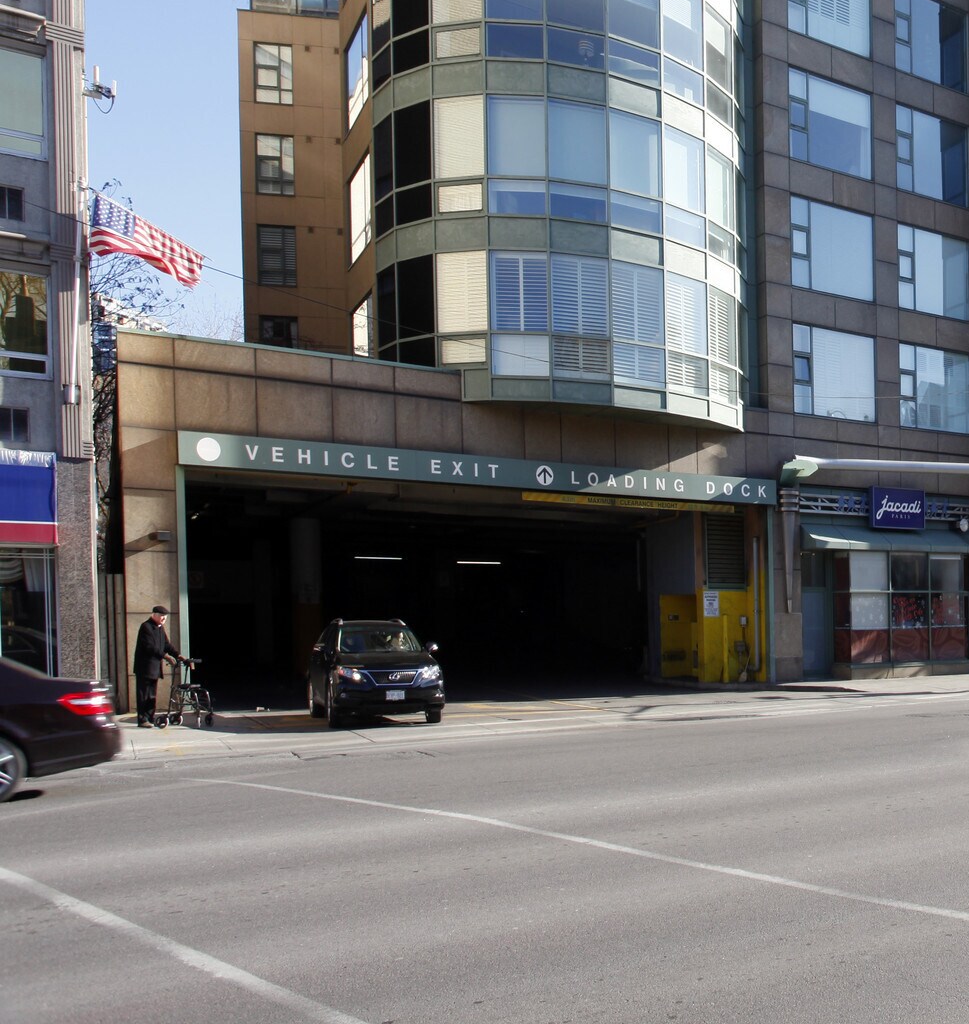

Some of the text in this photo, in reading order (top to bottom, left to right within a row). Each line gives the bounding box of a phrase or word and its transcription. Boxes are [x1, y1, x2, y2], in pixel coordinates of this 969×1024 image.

[245, 444, 499, 479] VEHICLE EXIT
[571, 470, 767, 499] LOADING DOCK
[587, 496, 615, 506] MAXIMUM
[620, 499, 654, 508] CLEARANCE
[876, 494, 922, 520] jacadi
